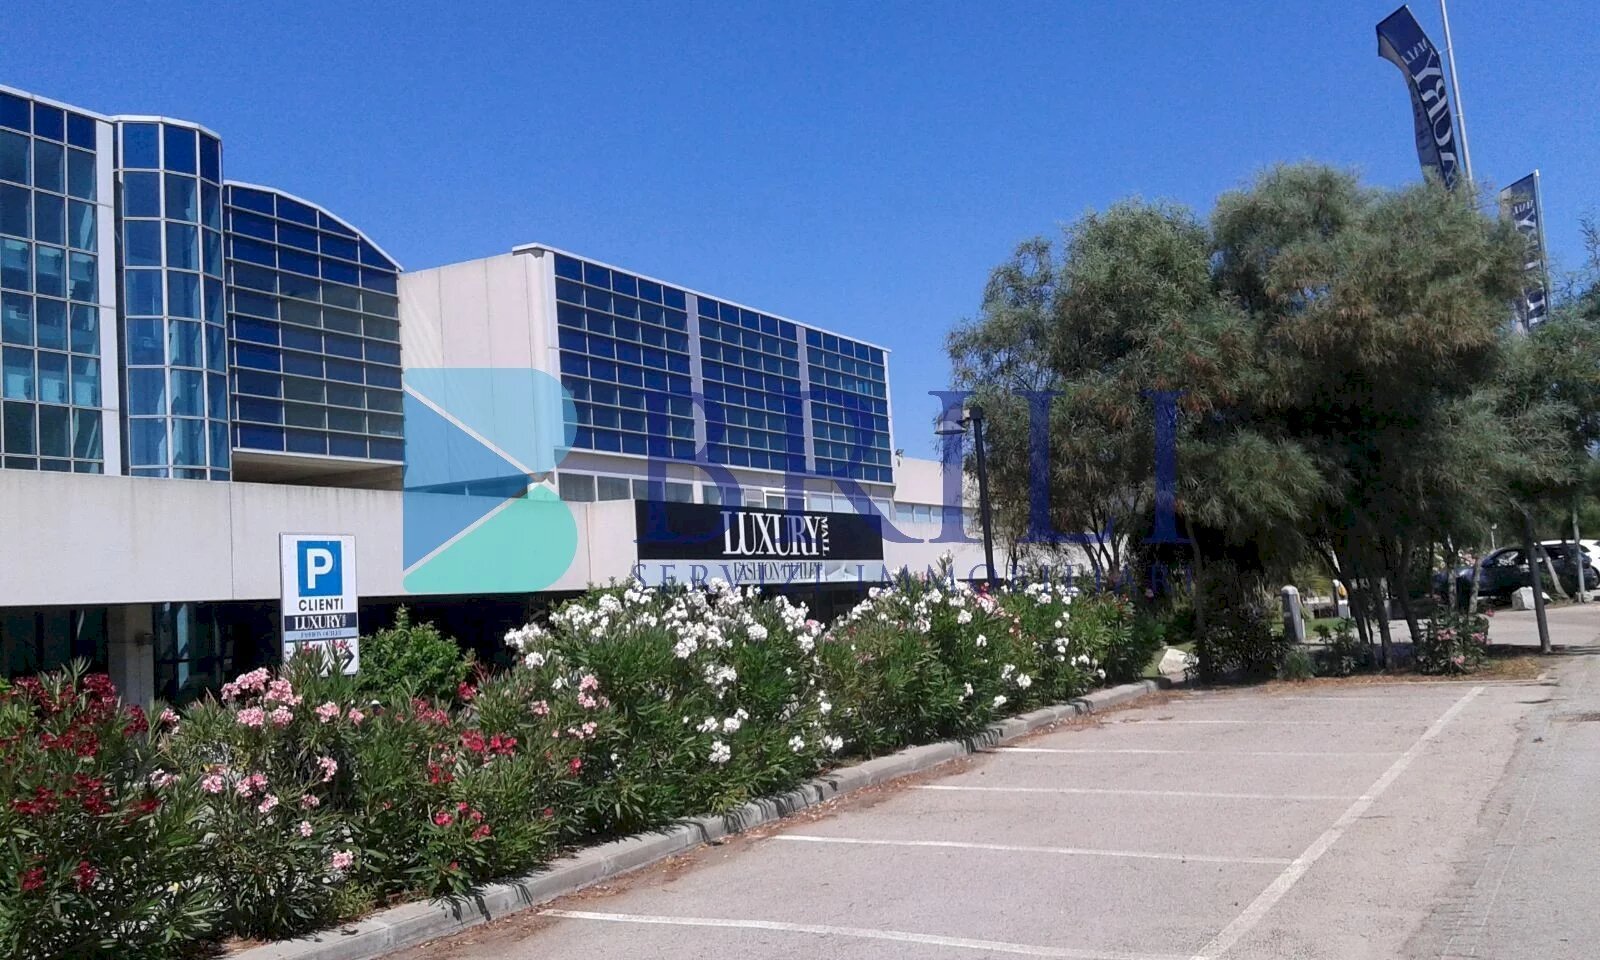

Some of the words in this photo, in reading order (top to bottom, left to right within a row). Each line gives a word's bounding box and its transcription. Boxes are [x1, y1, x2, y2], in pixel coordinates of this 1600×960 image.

[720, 511, 820, 556] LUXURY
[820, 515, 830, 557] MALL
[306, 548, 334, 589] P
[734, 562, 780, 581] FASHION
[783, 561, 822, 579] OUTLET
[298, 598, 344, 611] CLIENTI
[294, 614, 342, 630] LUXURY
